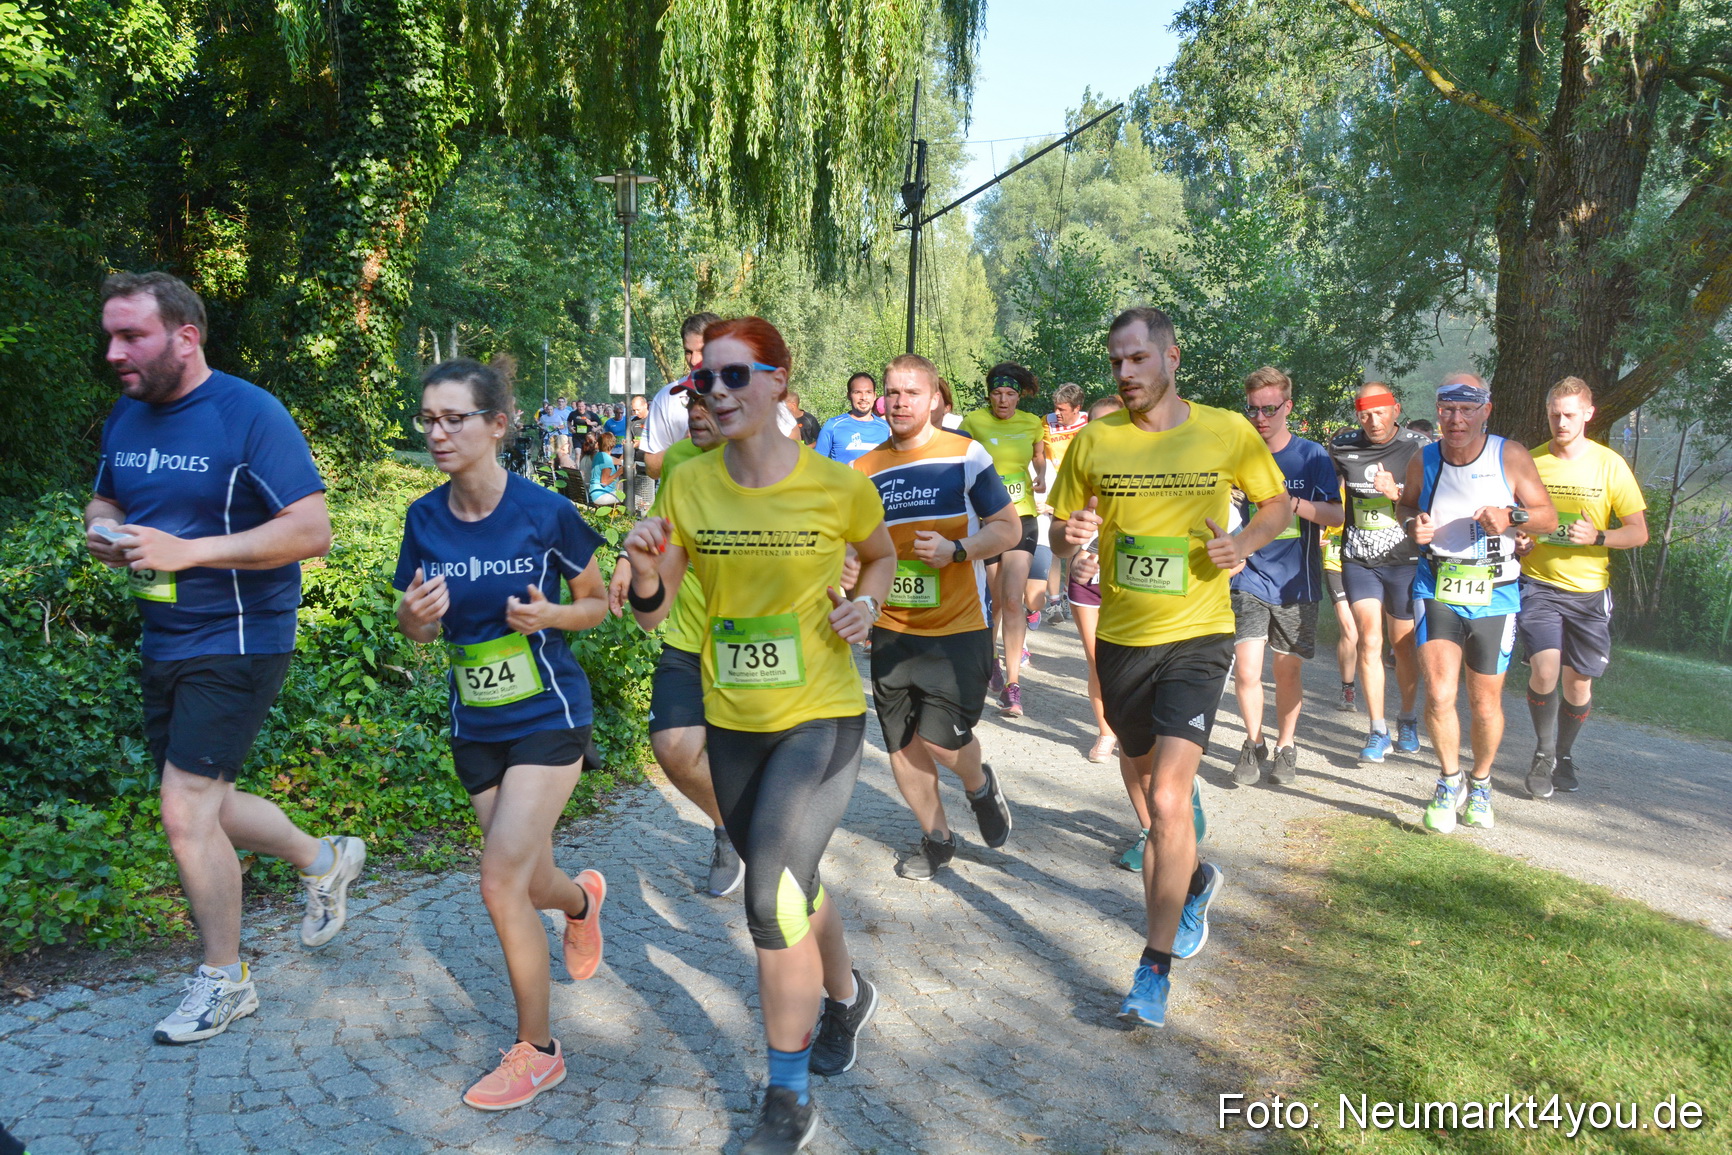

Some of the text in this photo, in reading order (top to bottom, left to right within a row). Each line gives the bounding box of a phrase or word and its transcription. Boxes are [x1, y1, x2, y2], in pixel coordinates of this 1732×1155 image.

[115, 452, 210, 473] EURO POLES
[882, 487, 940, 505] Fischer
[887, 499, 936, 511] AUTOMOBILE
[1363, 509, 1379, 521] 78
[794, 549, 817, 557] BÜRO
[430, 557, 534, 577] EURO POLES
[1126, 554, 1170, 578] 737
[893, 577, 925, 594] 568
[1125, 574, 1171, 586] Schmoll Philipp
[1442, 577, 1486, 595] 2114
[727, 642, 780, 669] 738
[465, 661, 516, 690] 524
[728, 669, 787, 677] Neumeier Bettina
